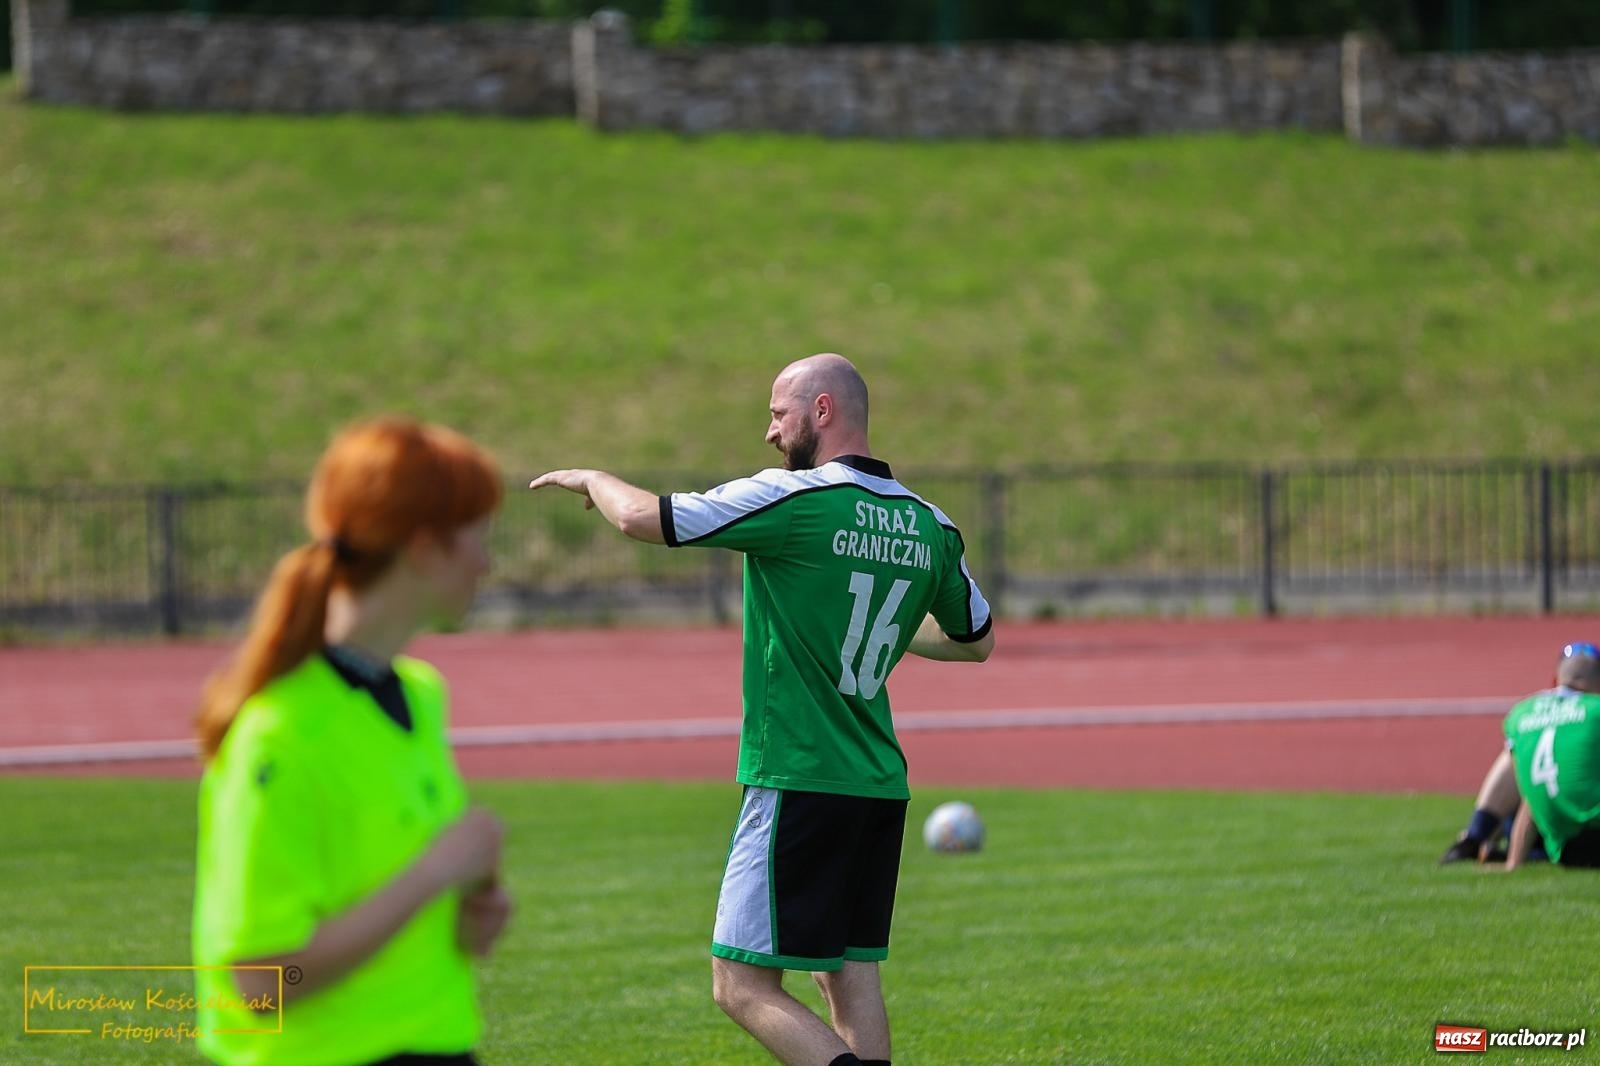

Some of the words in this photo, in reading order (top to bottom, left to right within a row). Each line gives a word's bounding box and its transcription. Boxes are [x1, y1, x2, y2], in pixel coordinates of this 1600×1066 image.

[855, 500, 920, 535] STRAŻ
[832, 529, 931, 571] GRANICZNA
[837, 571, 912, 700] 16
[1531, 727, 1560, 799] 4
